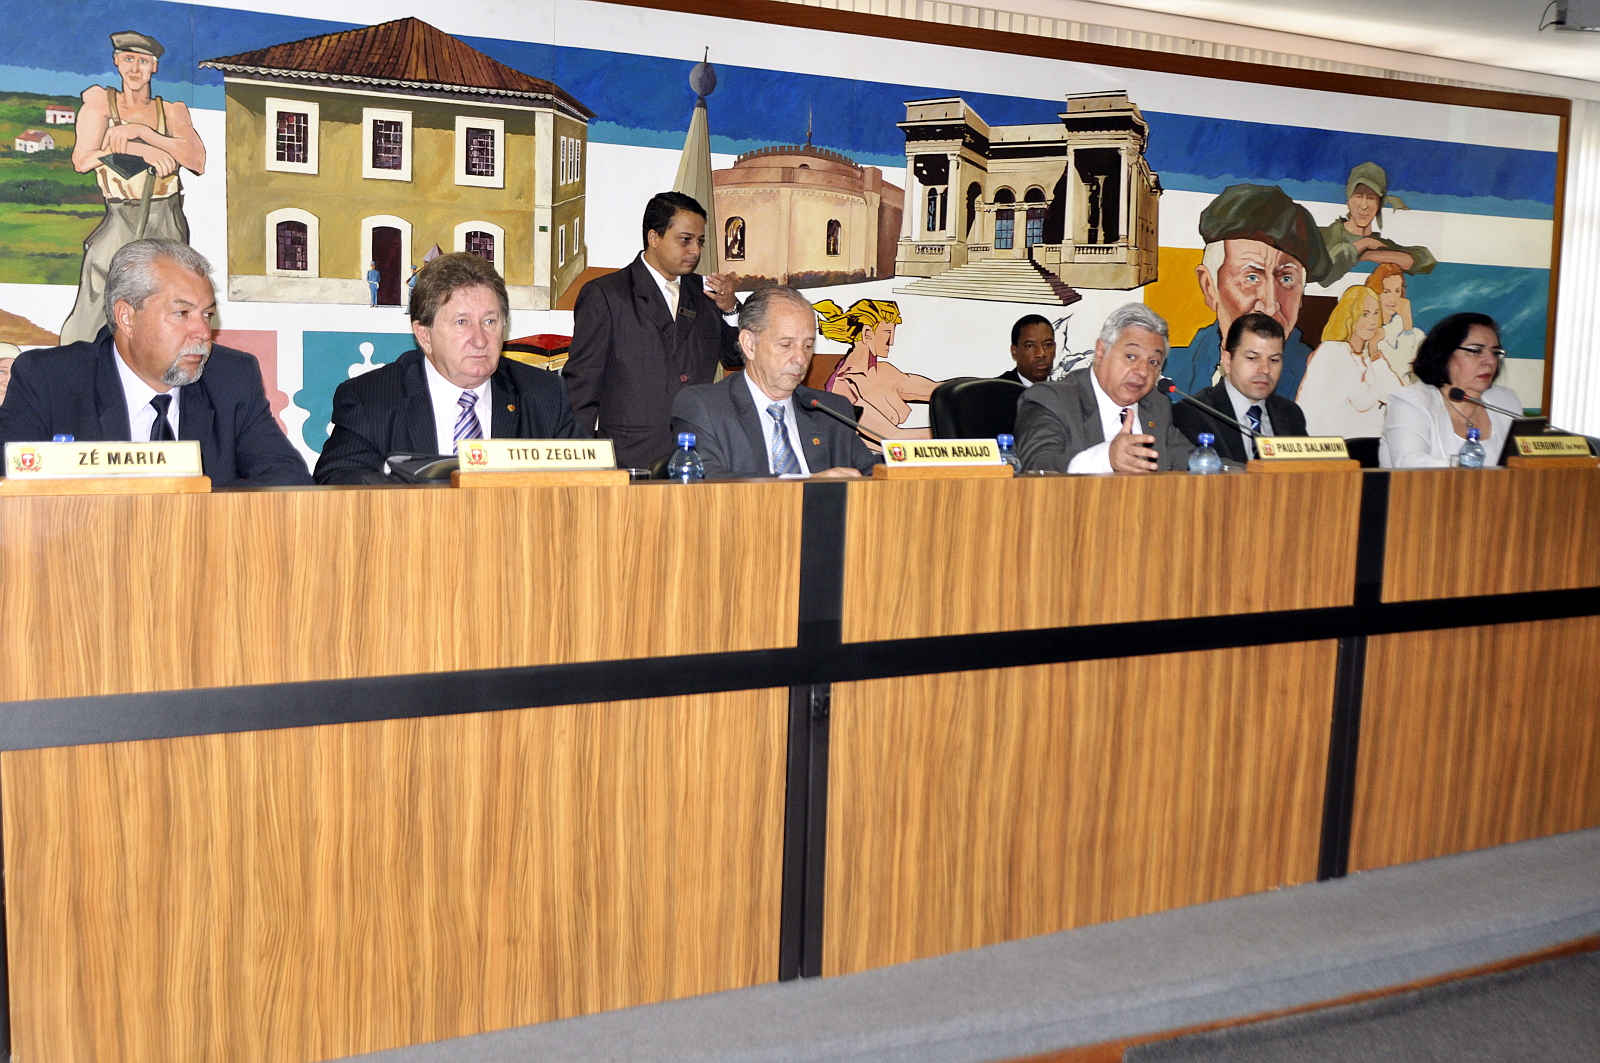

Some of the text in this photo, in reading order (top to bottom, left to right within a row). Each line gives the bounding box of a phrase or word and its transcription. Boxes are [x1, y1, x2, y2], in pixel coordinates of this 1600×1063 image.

[914, 446, 990, 458] AILTON ARAUJO
[1276, 442, 1346, 453] PAULO SALAMUNI
[1532, 441, 1565, 451] SERGINHO
[79, 449, 167, 466] ZÉ MARIA
[507, 448, 596, 460] TITO ZEGLIN
